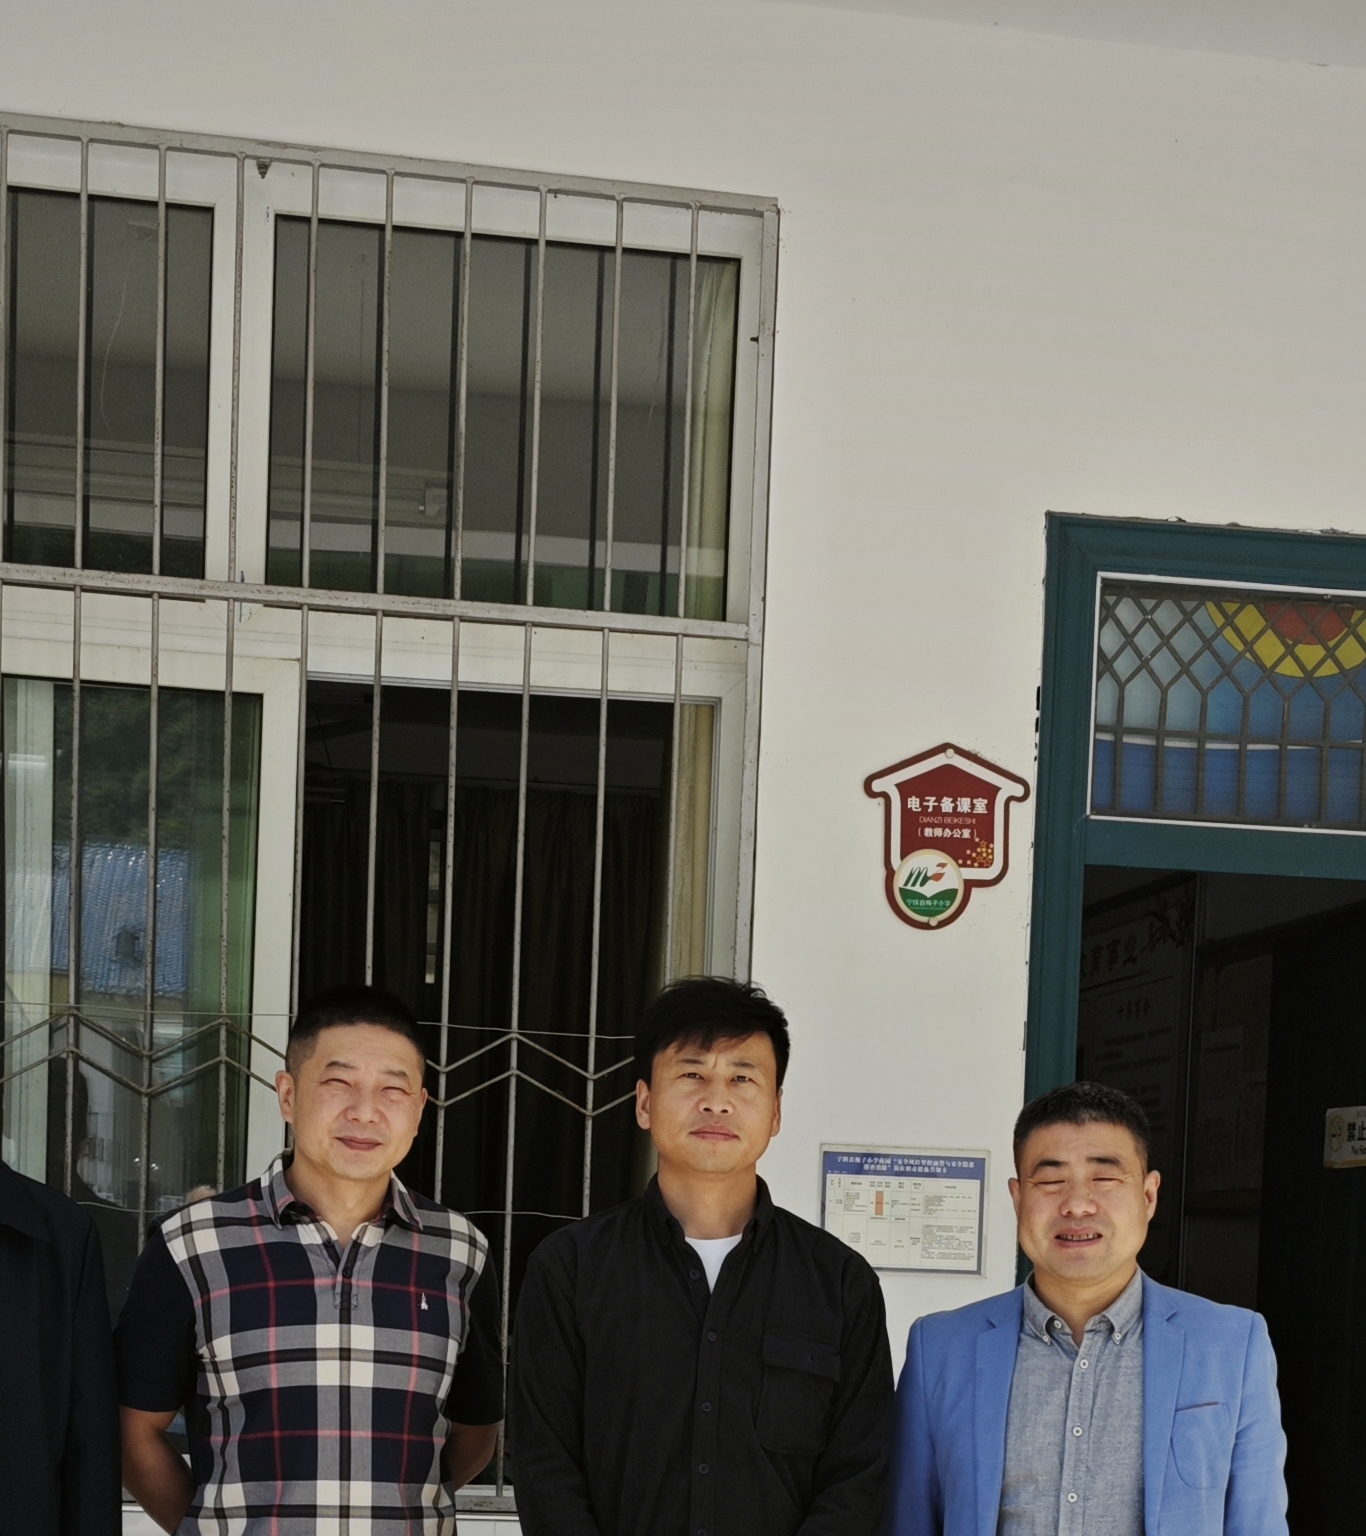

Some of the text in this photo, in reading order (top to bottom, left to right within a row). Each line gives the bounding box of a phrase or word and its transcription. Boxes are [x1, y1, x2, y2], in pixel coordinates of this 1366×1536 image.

[907, 796, 988, 814] 电子备课室
[919, 816, 976, 825] DIANZI BEIKESHI
